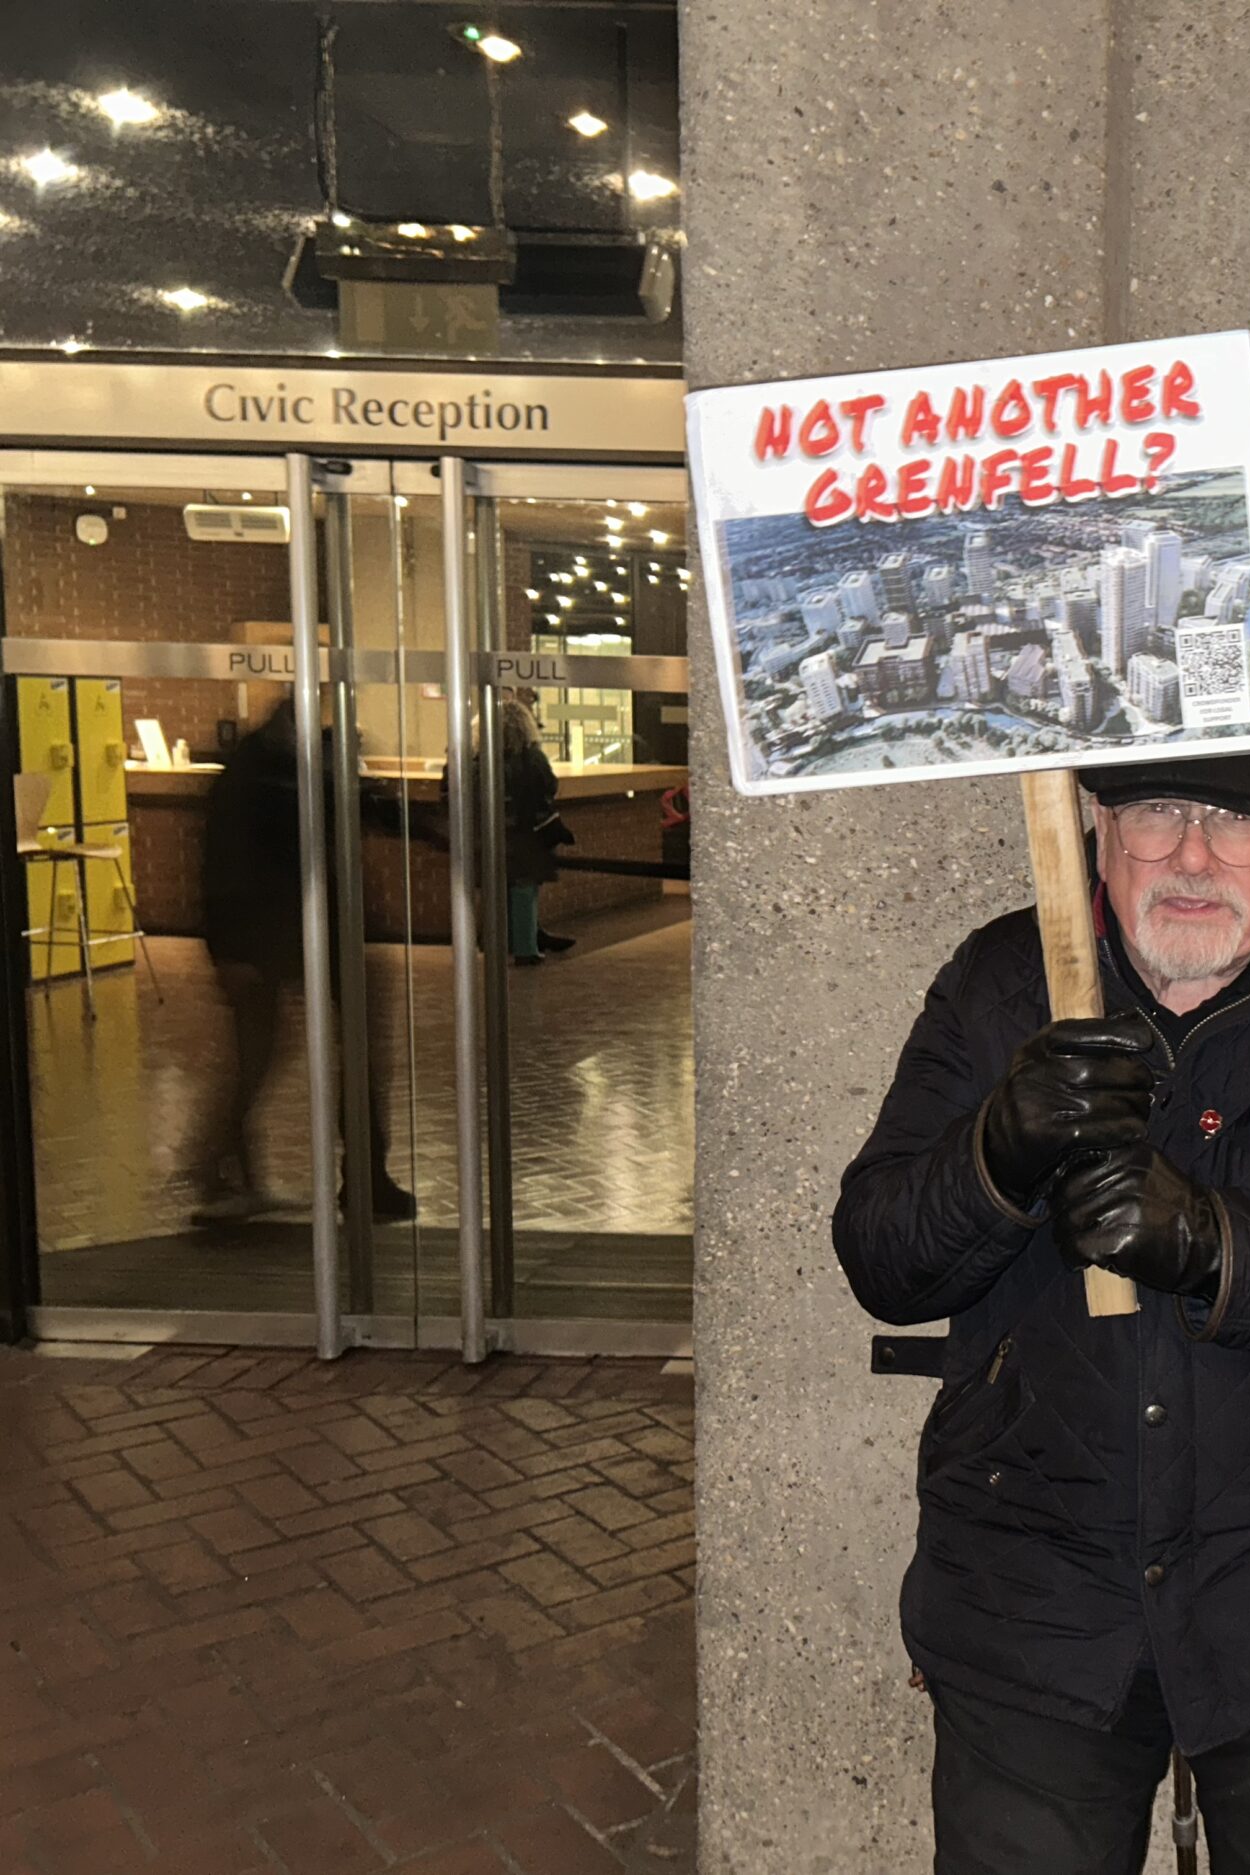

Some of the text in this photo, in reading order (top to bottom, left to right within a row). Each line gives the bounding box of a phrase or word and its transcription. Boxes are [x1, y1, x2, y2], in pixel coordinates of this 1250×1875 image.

[203, 382, 549, 441] Civic Reception
[753, 360, 1202, 462] NOT ANOTHER
[804, 432, 1177, 526] GRENFELL?
[229, 652, 295, 674] PULL
[497, 658, 566, 680] PULL
